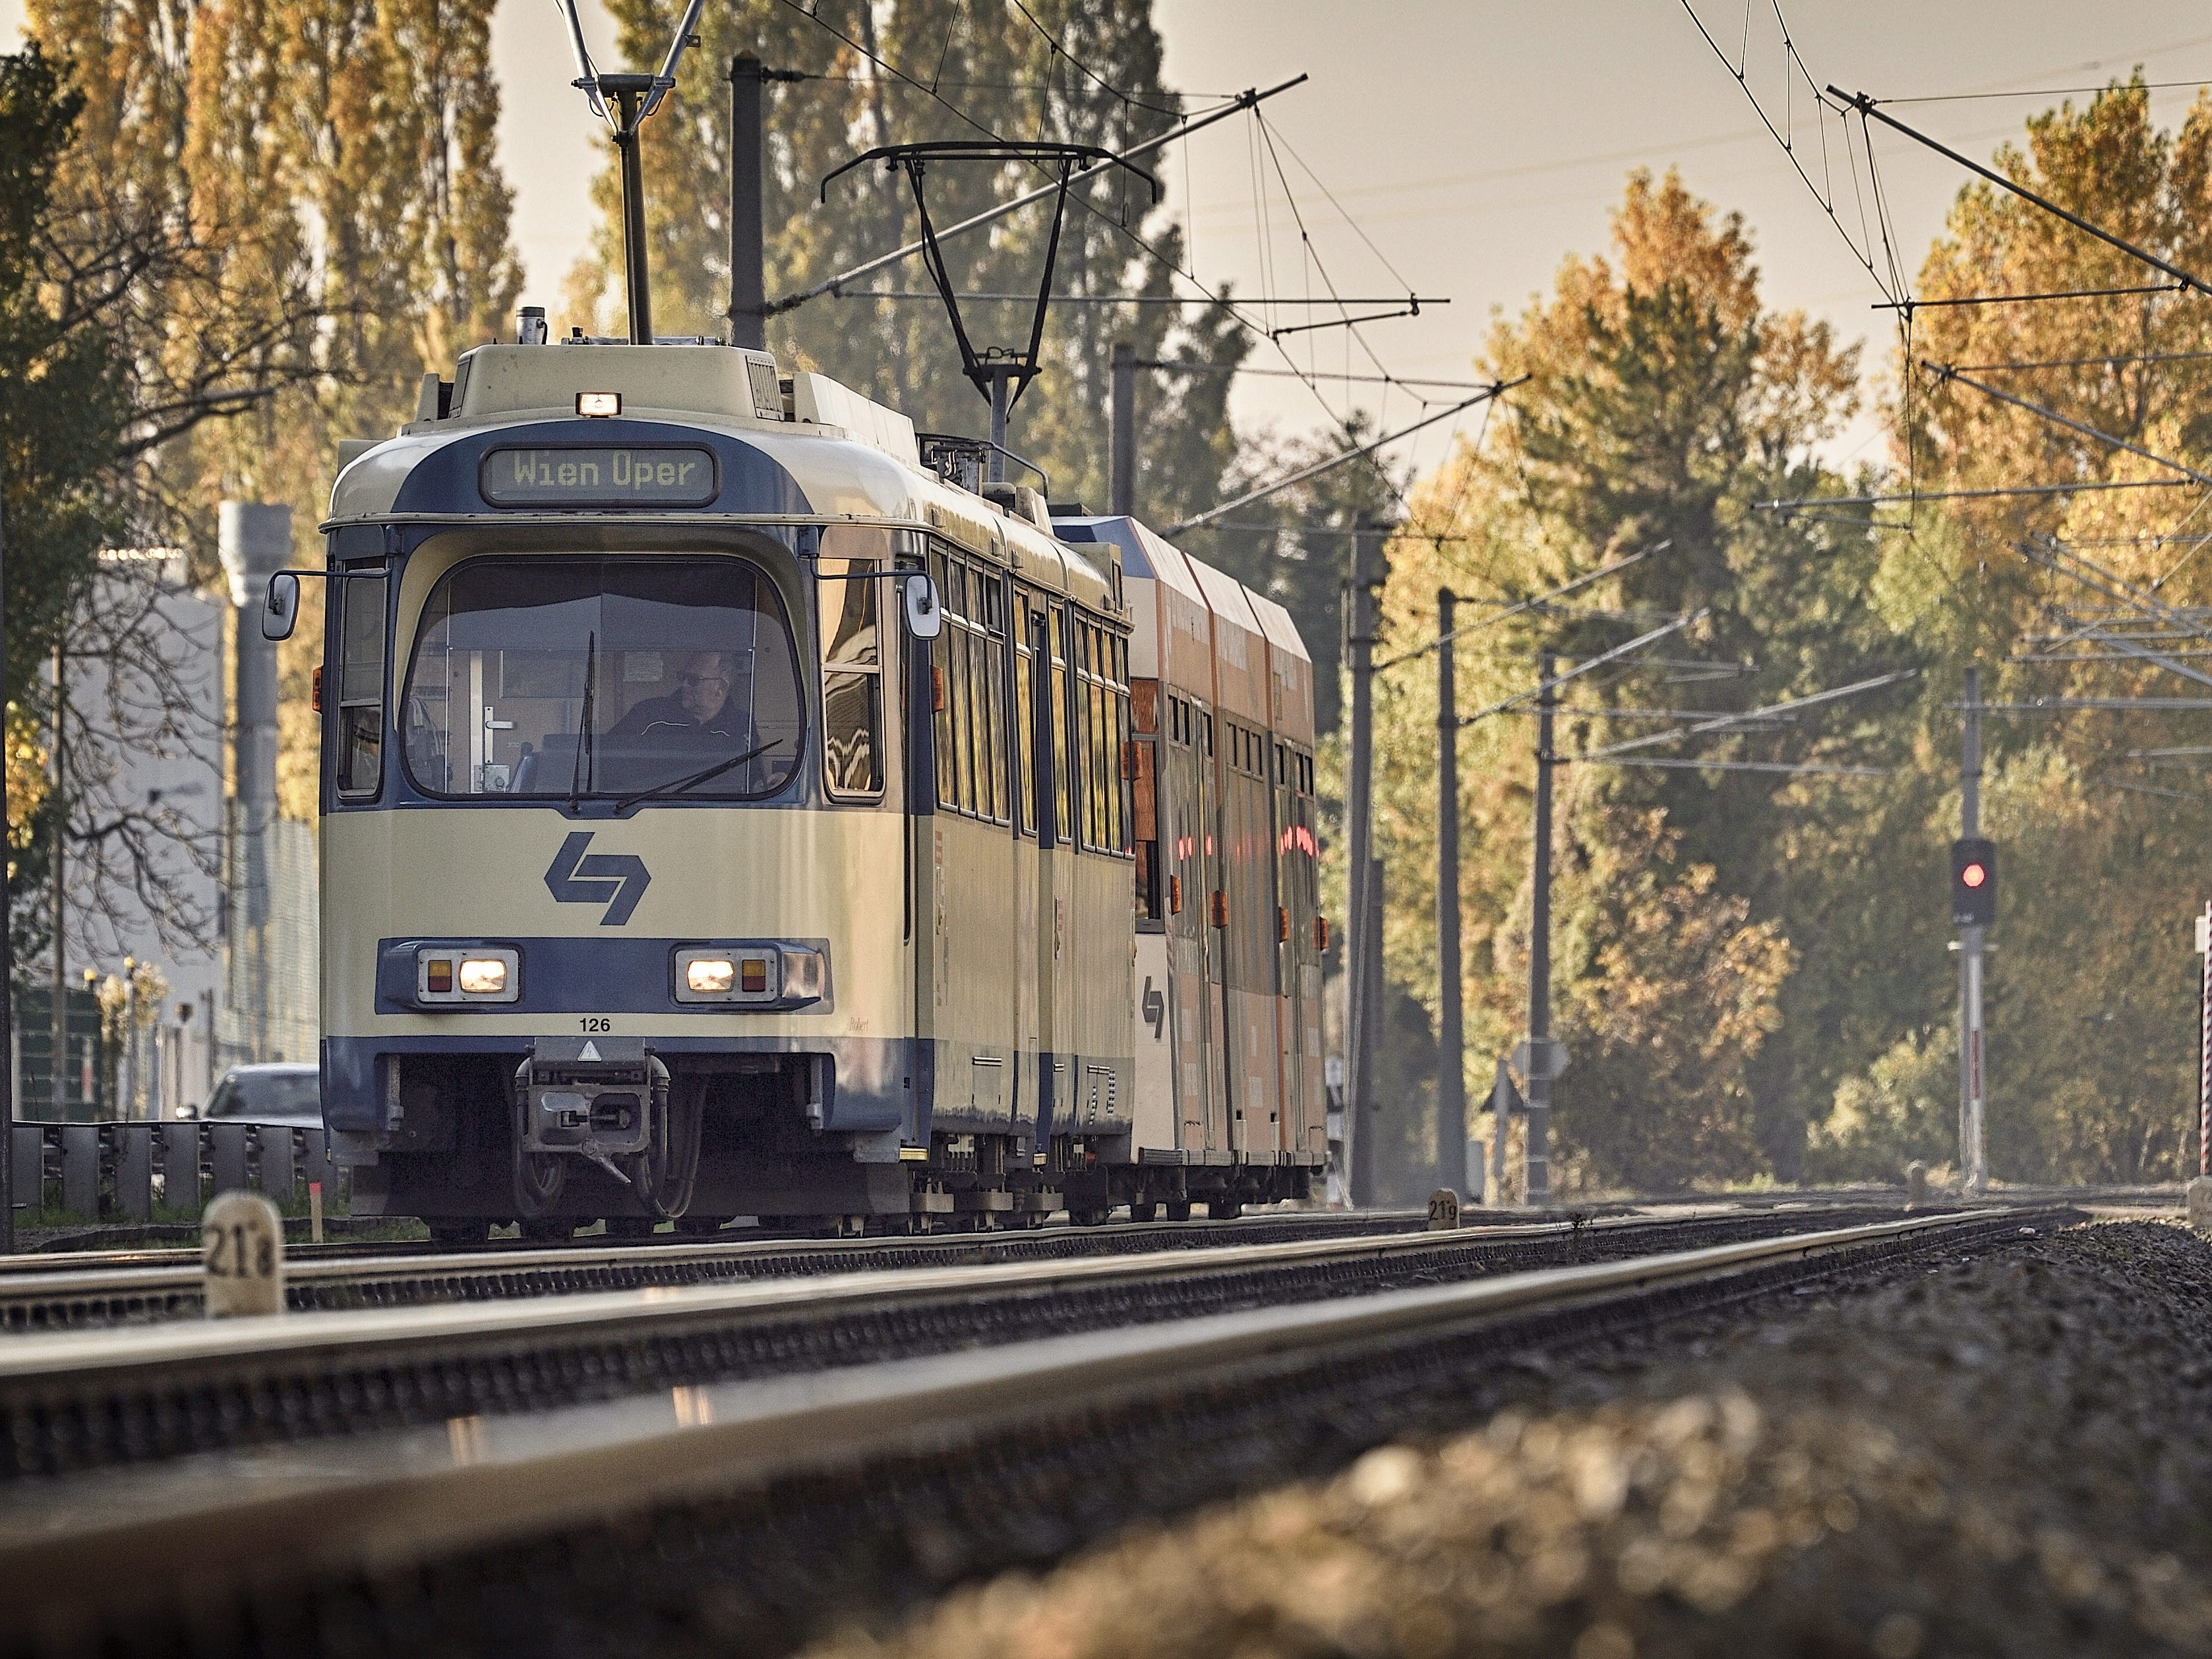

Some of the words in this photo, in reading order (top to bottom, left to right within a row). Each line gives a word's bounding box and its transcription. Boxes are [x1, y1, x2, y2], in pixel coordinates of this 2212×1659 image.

[514, 450, 599, 486] Wien
[612, 452, 695, 489] Oper
[580, 1017, 611, 1032] 126
